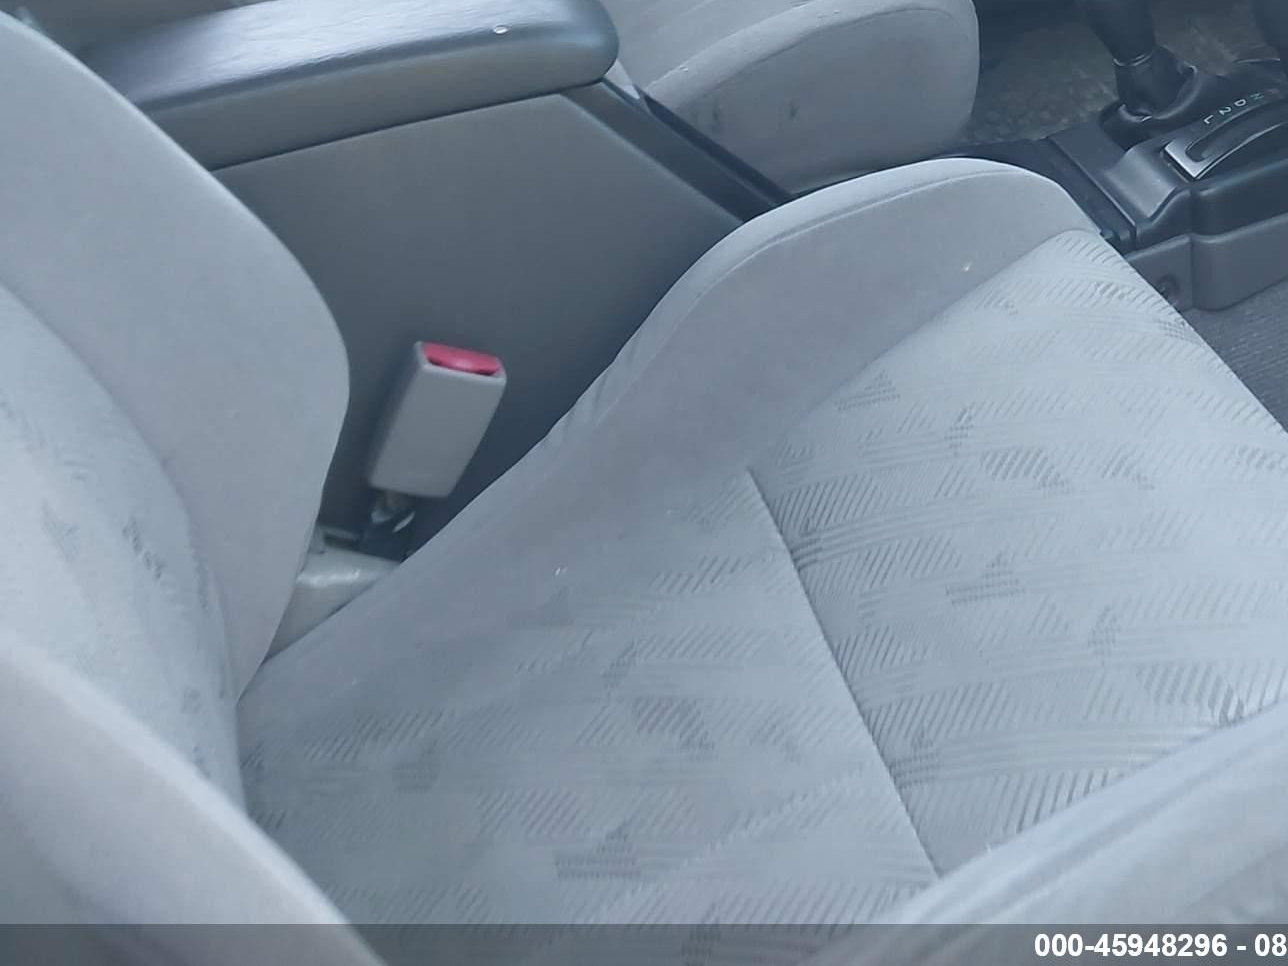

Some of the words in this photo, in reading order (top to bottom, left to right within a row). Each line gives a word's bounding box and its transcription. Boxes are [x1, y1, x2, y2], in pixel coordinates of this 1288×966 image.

[1233, 98, 1247, 107] D
[1219, 106, 1232, 115] 2
[1203, 114, 1214, 125] L
